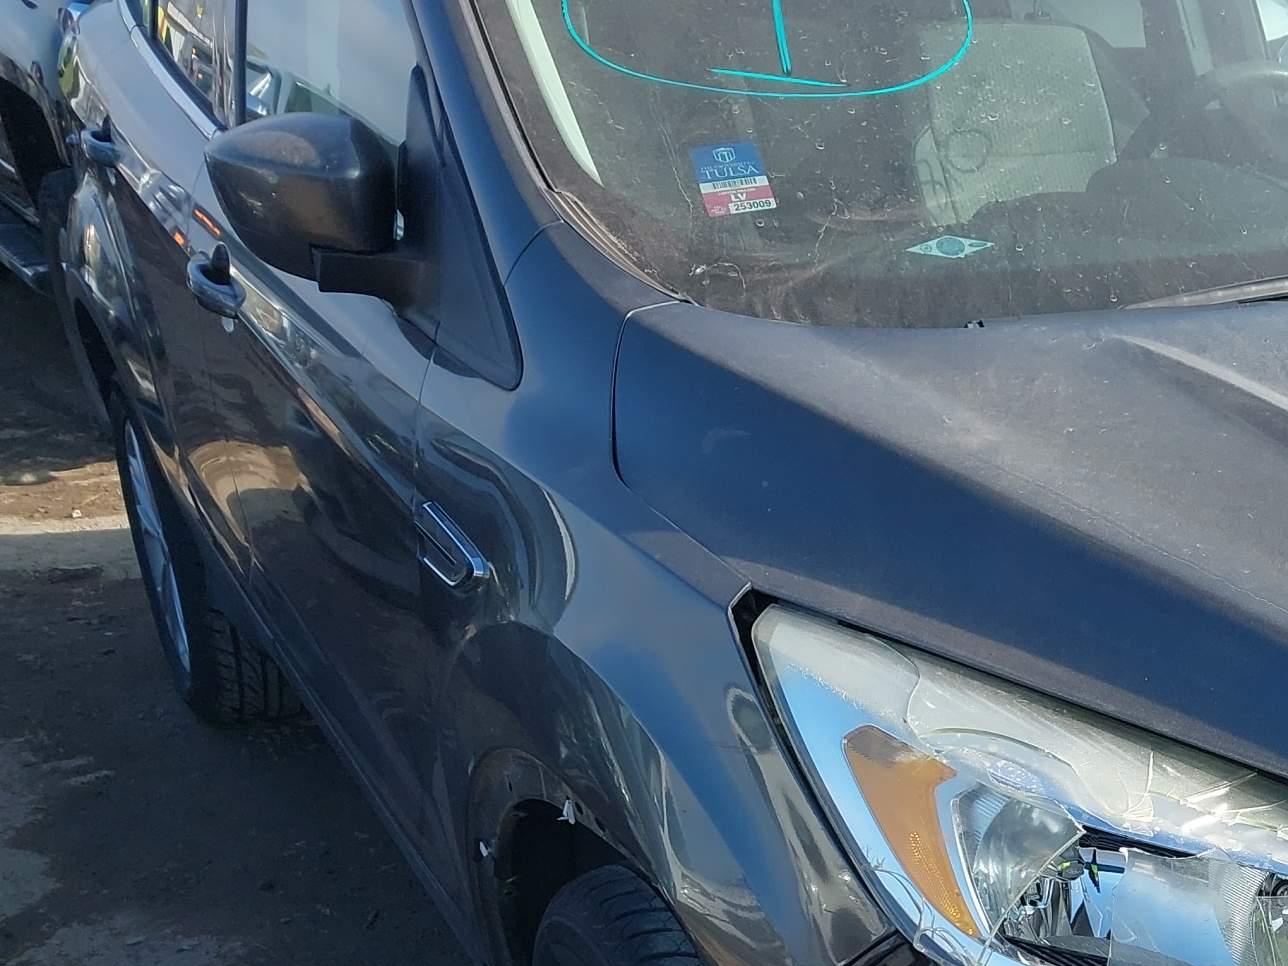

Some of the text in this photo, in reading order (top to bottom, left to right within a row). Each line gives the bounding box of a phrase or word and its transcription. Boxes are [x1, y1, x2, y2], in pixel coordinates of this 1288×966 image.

[703, 164, 760, 179] TULSA
[730, 192, 747, 202] LV
[733, 199, 772, 212] 253009
